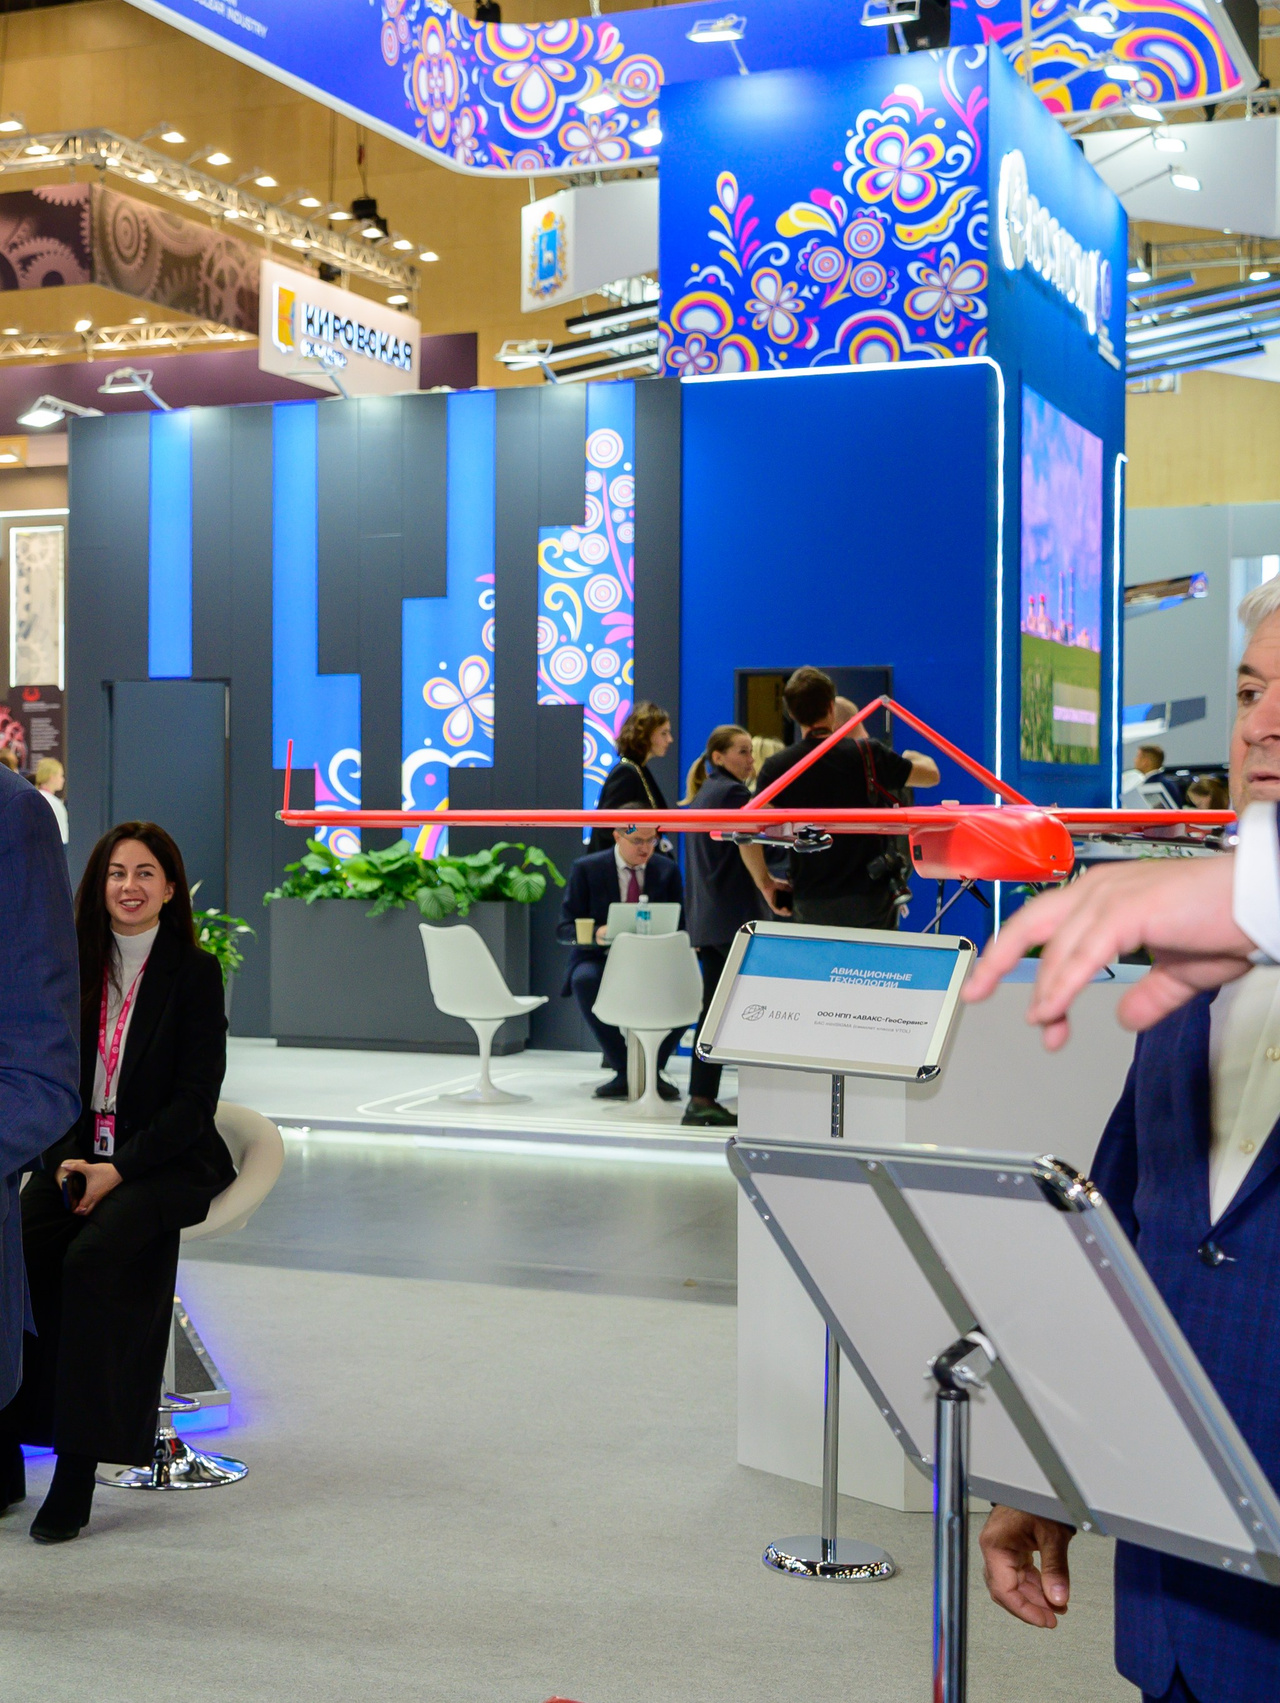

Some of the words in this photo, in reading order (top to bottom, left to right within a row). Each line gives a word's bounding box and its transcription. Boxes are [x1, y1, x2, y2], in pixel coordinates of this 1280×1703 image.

[301, 302, 412, 371] КИРОВСКАЯ
[829, 975, 899, 989] ТЕХНОЛОГИИ
[830, 967, 913, 982] АВИАЦИОННЫЕ
[768, 1011, 801, 1022] АВАКС
[816, 1010, 834, 1018] ООО
[852, 1013, 929, 1026] «АВАКС-ГеоСервис»
